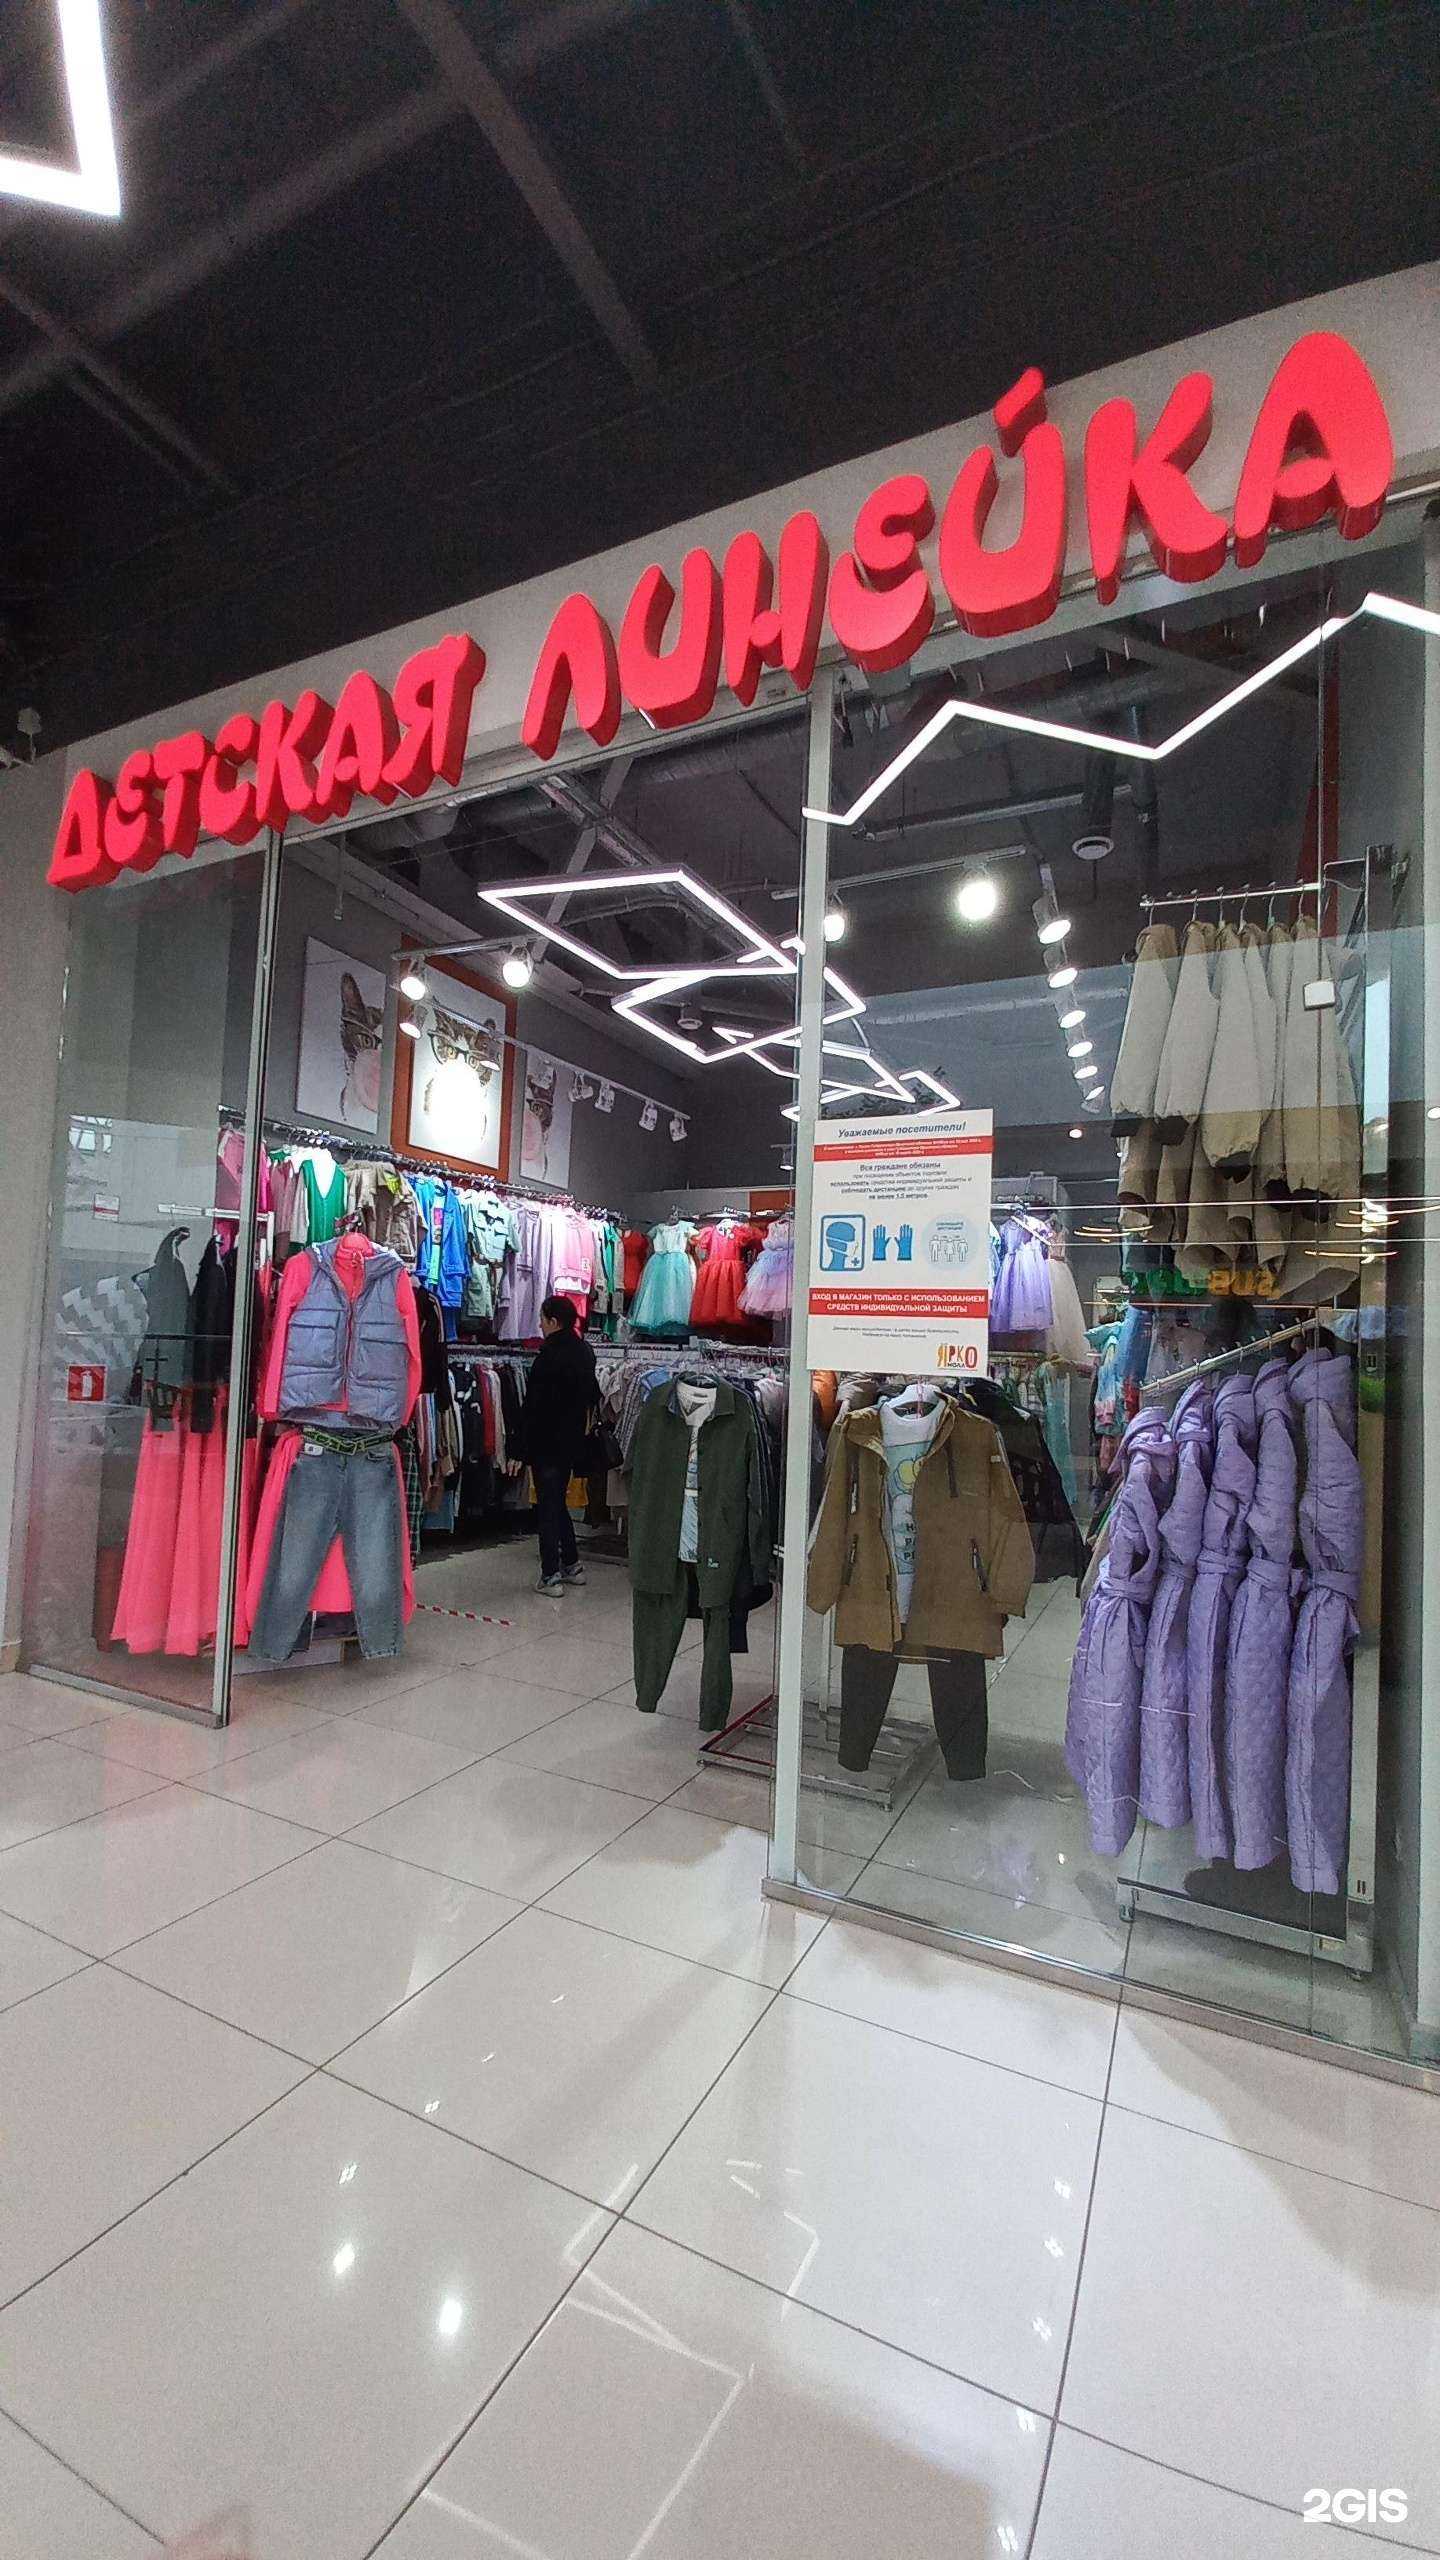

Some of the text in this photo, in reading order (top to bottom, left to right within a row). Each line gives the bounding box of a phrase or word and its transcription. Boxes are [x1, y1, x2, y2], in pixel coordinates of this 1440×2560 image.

[46, 330, 1394, 894] ДЕТСКАЯ ЛИНЕЙКА
[895, 1121, 966, 1134] посетители!
[812, 1293, 831, 1301] ВХОД
[832, 1293, 838, 1301] В
[838, 1293, 872, 1301] МАГАЗИН
[873, 1294, 902, 1302] ТОЛЬКО
[911, 1294, 986, 1303] ИСПОЛЬЗОВАНИЕМ
[826, 1303, 968, 1314] СРЕДСТВ ИНДИВИДУАЛЬНОЙ ЗАЩИТЫ
